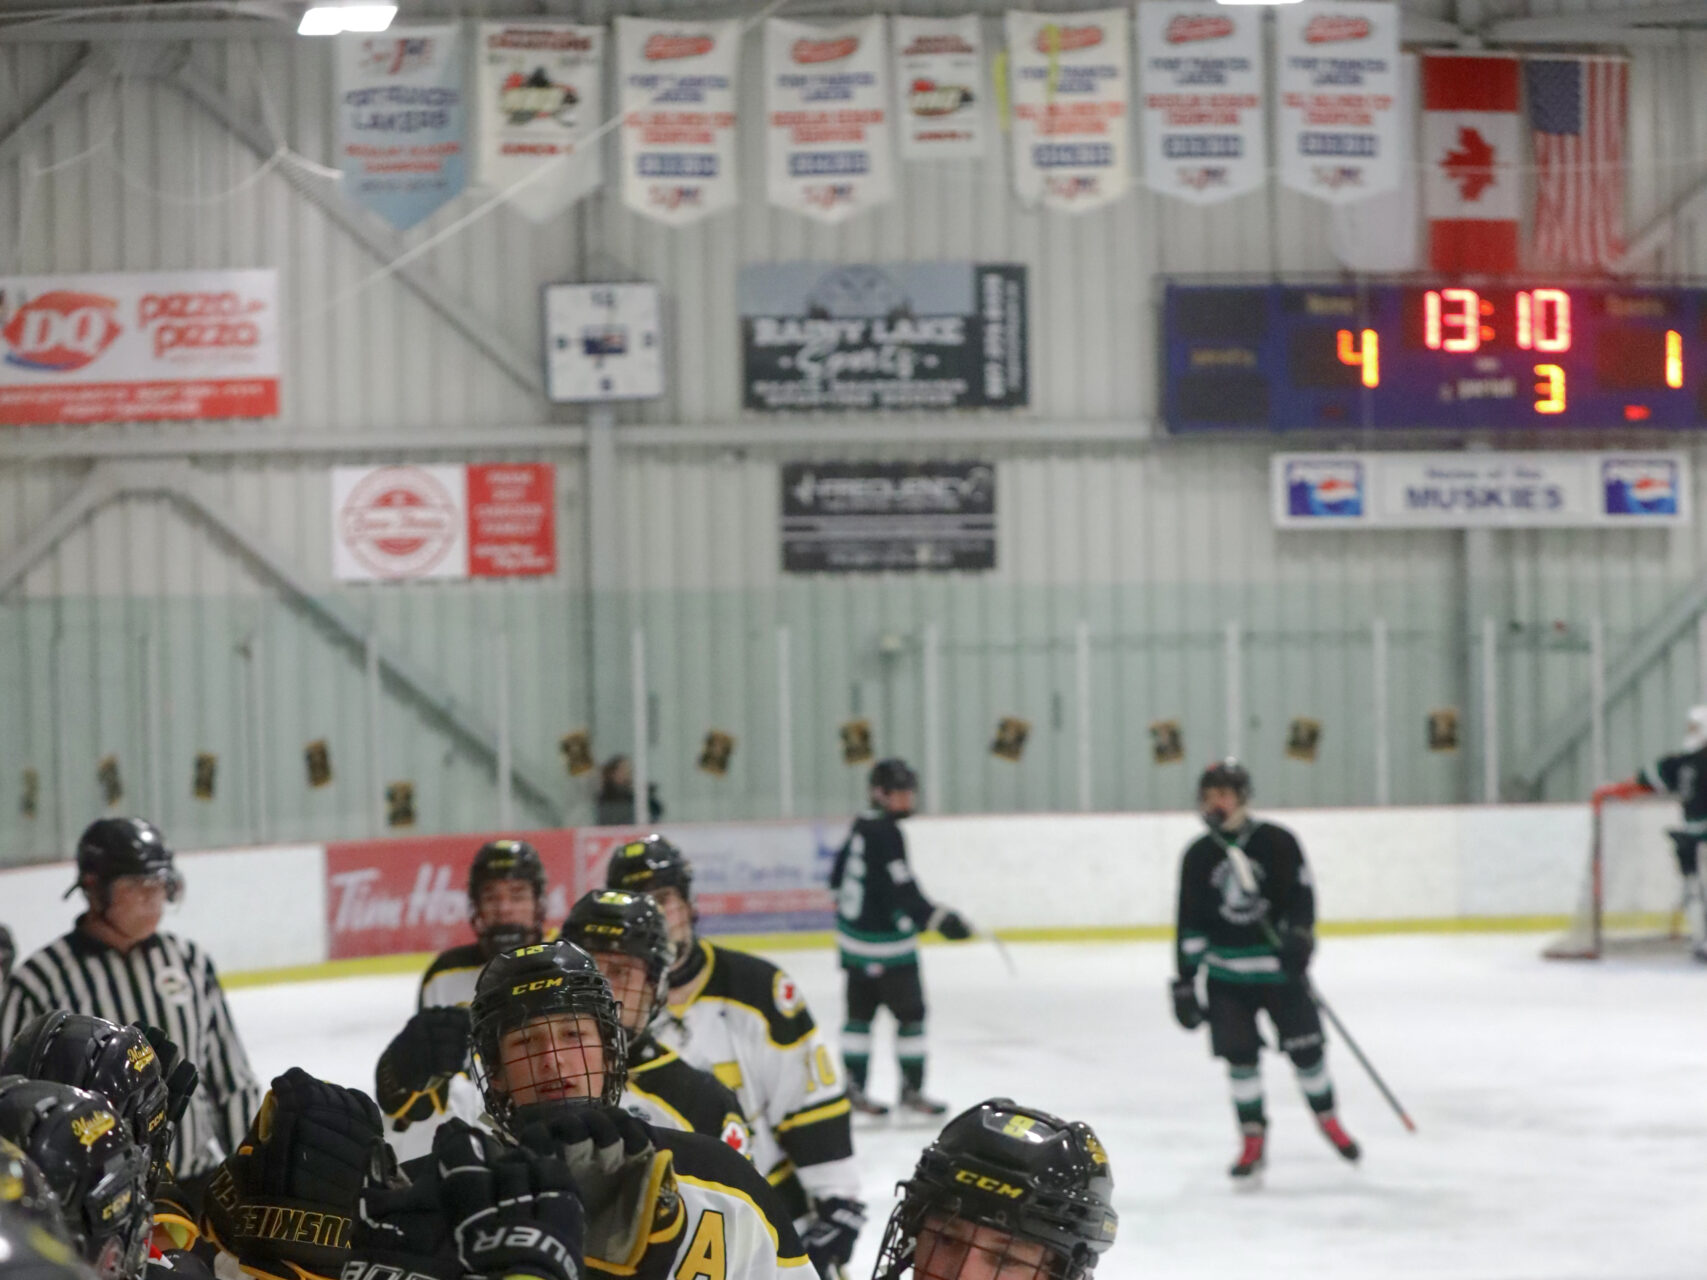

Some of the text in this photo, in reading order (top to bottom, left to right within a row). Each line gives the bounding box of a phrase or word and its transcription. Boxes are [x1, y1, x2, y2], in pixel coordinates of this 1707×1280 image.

[23, 309, 108, 352] DQ
[1336, 328, 1380, 388] 4
[1665, 330, 1684, 390] 1
[1533, 363, 1567, 415] 3
[1405, 485, 1564, 512] MUSKIES
[331, 866, 402, 934] Tim
[511, 977, 563, 996] CCM
[955, 1170, 1023, 1198] CCM
